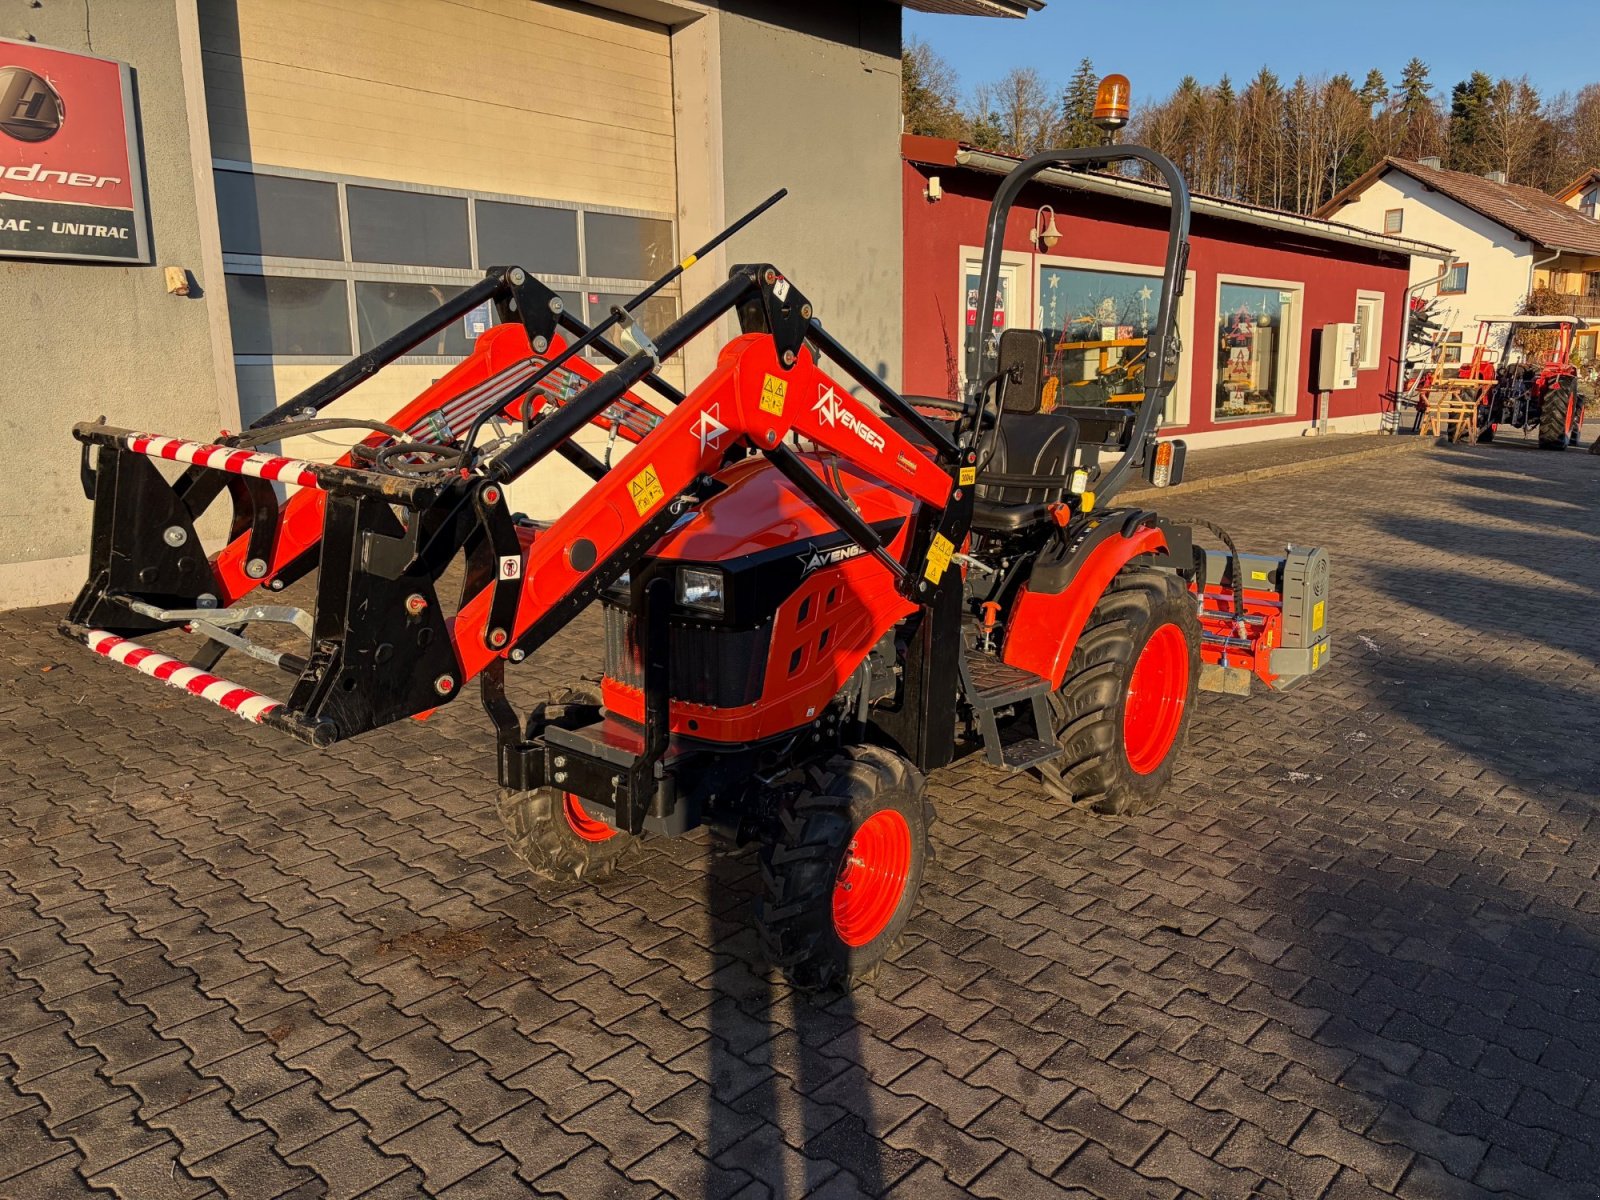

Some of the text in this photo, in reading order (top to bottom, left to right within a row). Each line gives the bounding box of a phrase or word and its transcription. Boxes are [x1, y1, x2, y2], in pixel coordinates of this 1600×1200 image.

[0, 164, 121, 188] dner
[51, 221, 129, 239] UNITRAC
[810, 385, 886, 453] AVENGER
[806, 545, 868, 570] AVENG
